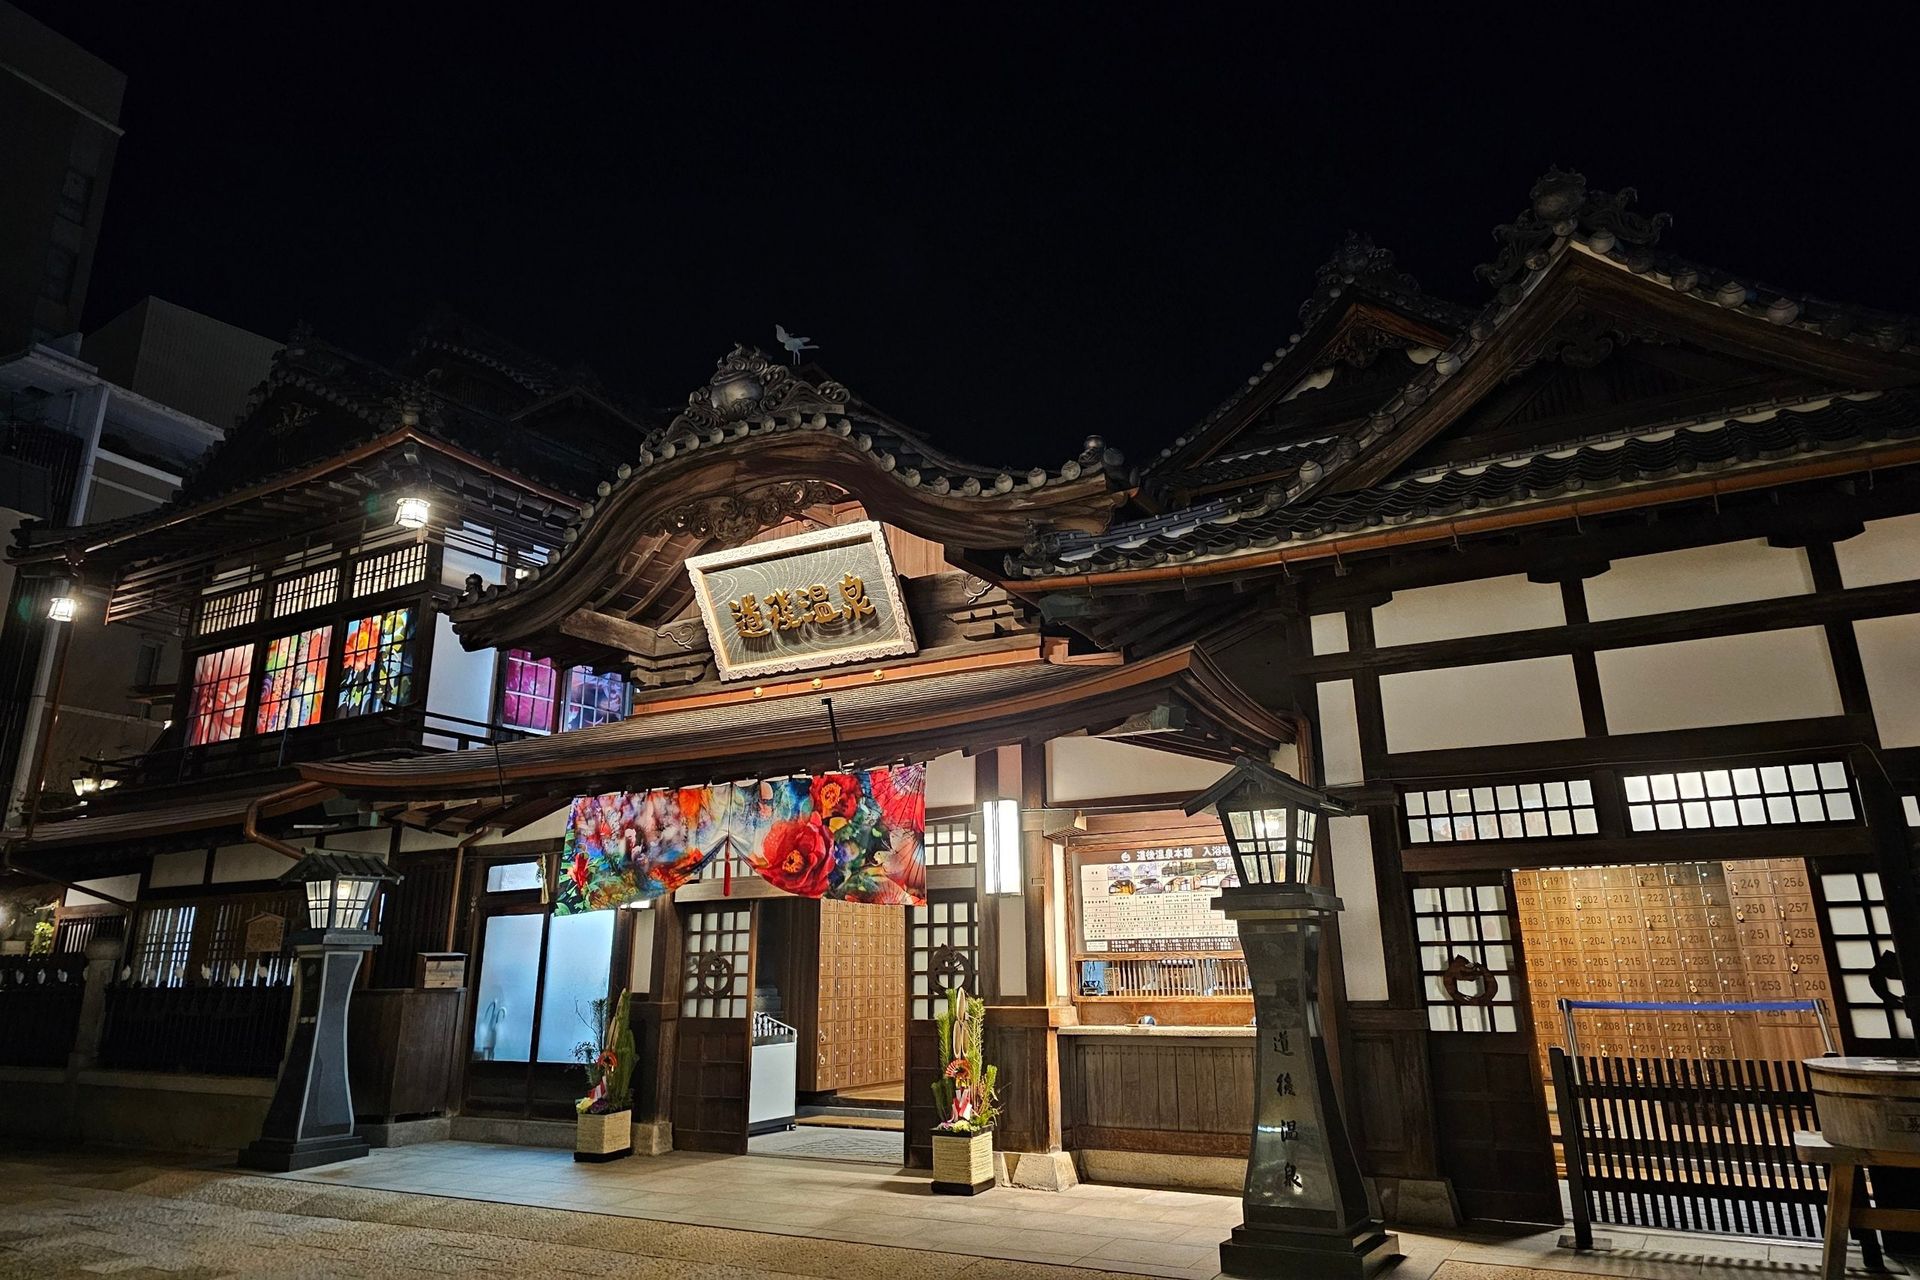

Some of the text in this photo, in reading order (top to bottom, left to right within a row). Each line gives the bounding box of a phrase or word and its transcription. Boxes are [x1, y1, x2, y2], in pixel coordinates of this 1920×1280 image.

[728, 571, 876, 638] 道後温泉
[1136, 847, 1193, 861] 道後温泉本館
[1550, 876, 1563, 885] 191
[1644, 873, 1660, 881] 221
[1518, 878, 1531, 886] 181
[1741, 879, 1760, 889] 249
[1784, 878, 1804, 887] 256
[1582, 896, 1597, 904] 202
[1614, 895, 1629, 903] 212
[1746, 904, 1765, 913] 250
[1789, 903, 1808, 912] 257
[1556, 917, 1570, 925] 193
[1617, 915, 1633, 923] 213
[1652, 914, 1668, 922] 223
[1751, 929, 1769, 939] 251
[1795, 929, 1815, 938] 258
[1621, 936, 1637, 944] 214
[1656, 936, 1672, 944] 224
[1563, 958, 1577, 966] 195
[1625, 957, 1641, 965] 215
[1660, 957, 1676, 965] 225
[1693, 956, 1709, 964] 235
[1757, 955, 1776, 964] 252
[1801, 955, 1819, 964] 259
[1534, 979, 1547, 987] 186
[1566, 979, 1580, 987] 196
[1597, 979, 1612, 987] 206
[1629, 979, 1644, 987] 216
[1664, 979, 1680, 987] 226
[1697, 979, 1713, 987] 236
[1760, 981, 1781, 990] 253
[1805, 980, 1825, 990] 260
[1604, 1022, 1620, 1030] 208
[1636, 1022, 1652, 1031] 218
[1672, 1023, 1688, 1031] 228
[1705, 1023, 1721, 1031] 238
[1607, 1044, 1623, 1052] 209
[1675, 1045, 1691, 1053] 229
[1709, 1045, 1725, 1054] 239
[1273, 1030, 1303, 1188] 道後温泉
